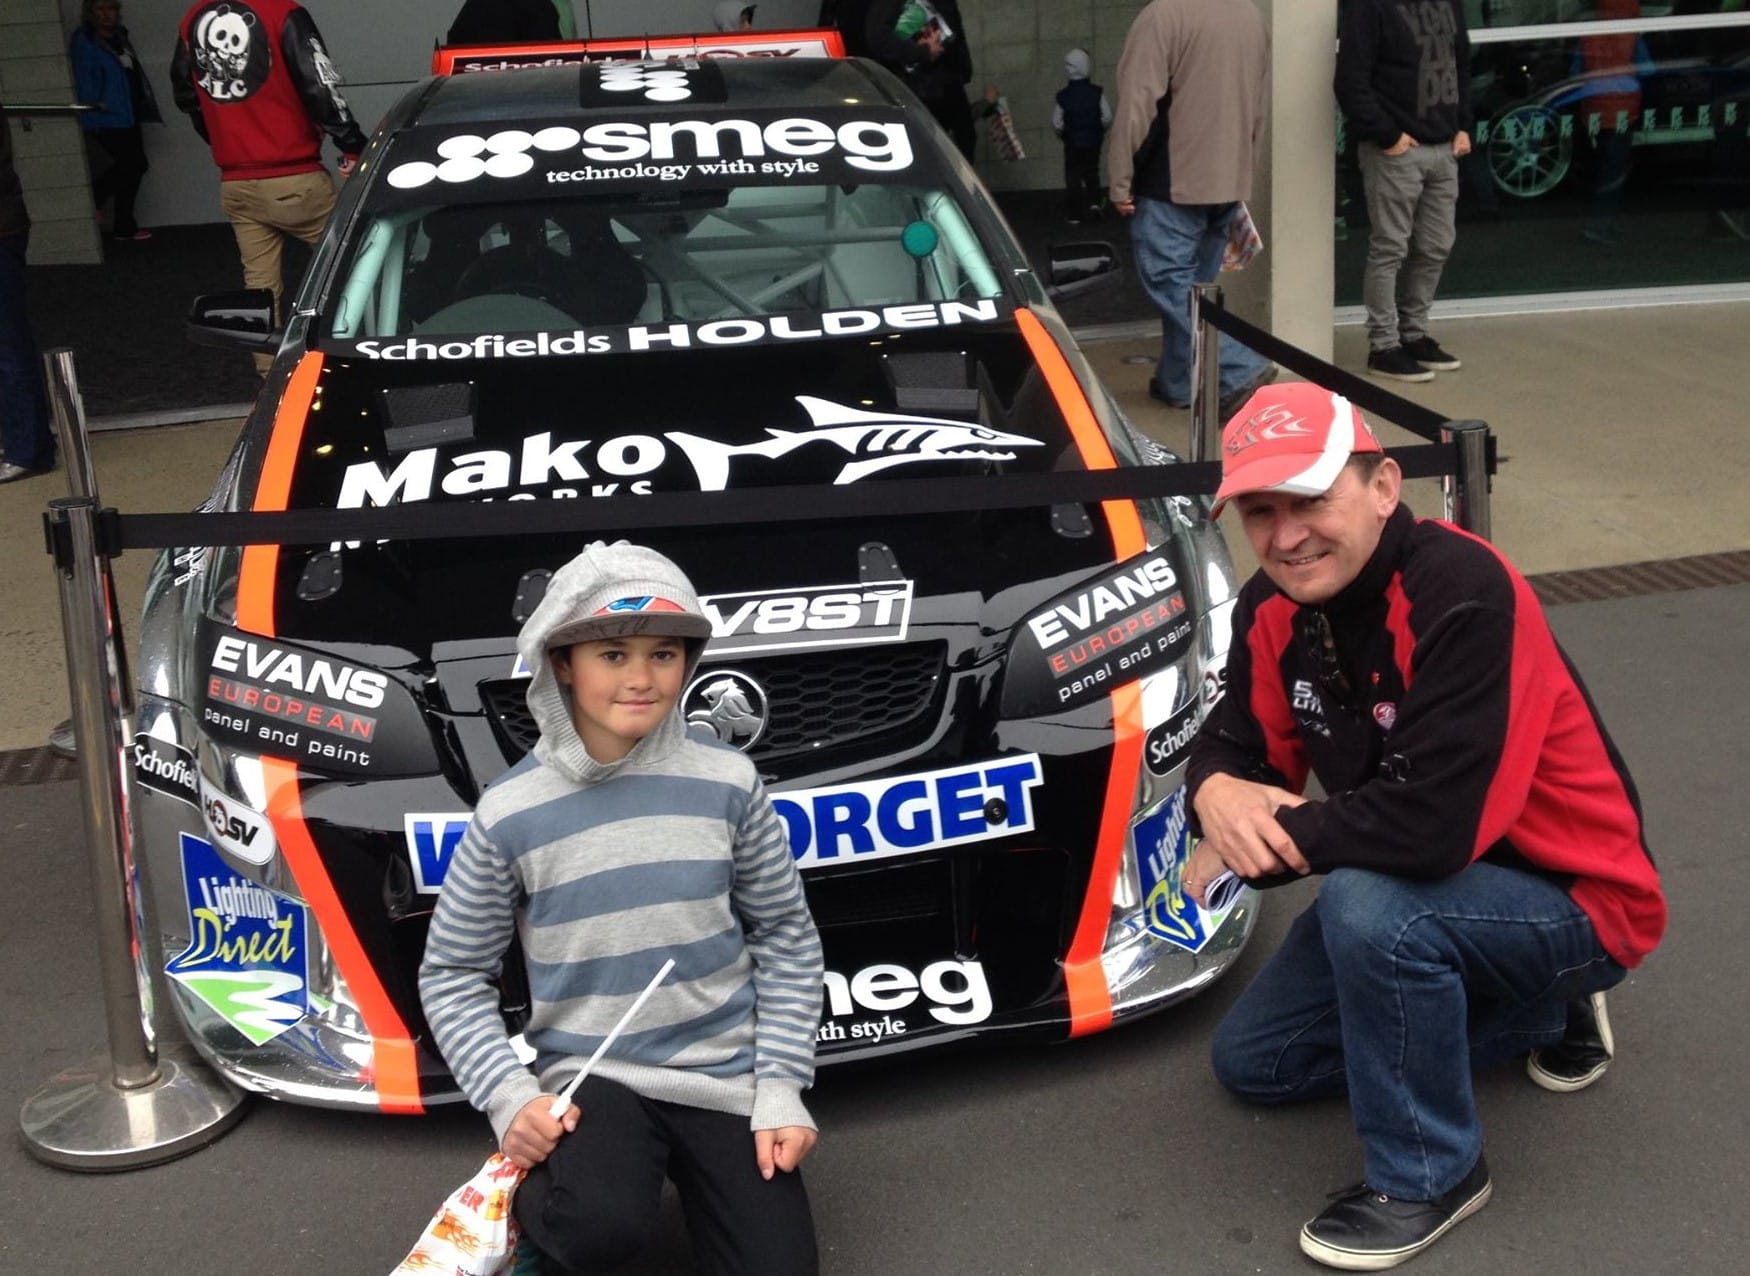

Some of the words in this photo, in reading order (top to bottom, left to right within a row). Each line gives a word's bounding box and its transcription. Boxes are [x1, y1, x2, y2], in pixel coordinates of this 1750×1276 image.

[198, 73, 248, 99] ALC
[546, 165, 692, 182] technology
[696, 158, 756, 175] with
[764, 158, 820, 176] style
[582, 118, 914, 172] smeg
[355, 331, 612, 361] Schofields
[628, 299, 998, 350] HOLDEN
[336, 431, 667, 510] Mako
[1028, 557, 1177, 650] EVANS
[1052, 595, 1186, 674] EUROPEAN
[210, 635, 388, 709] EVANS
[1059, 662, 1113, 703] panel
[1119, 643, 1153, 671] and
[1157, 621, 1193, 652] paint
[205, 707, 250, 734] panel
[258, 726, 299, 747] and
[308, 739, 370, 767] paint
[208, 677, 375, 739] EUROPEAN
[771, 761, 1037, 862] ORGET
[198, 876, 278, 930] Lighting
[177, 908, 296, 968] Direct
[851, 1015, 906, 1043] style
